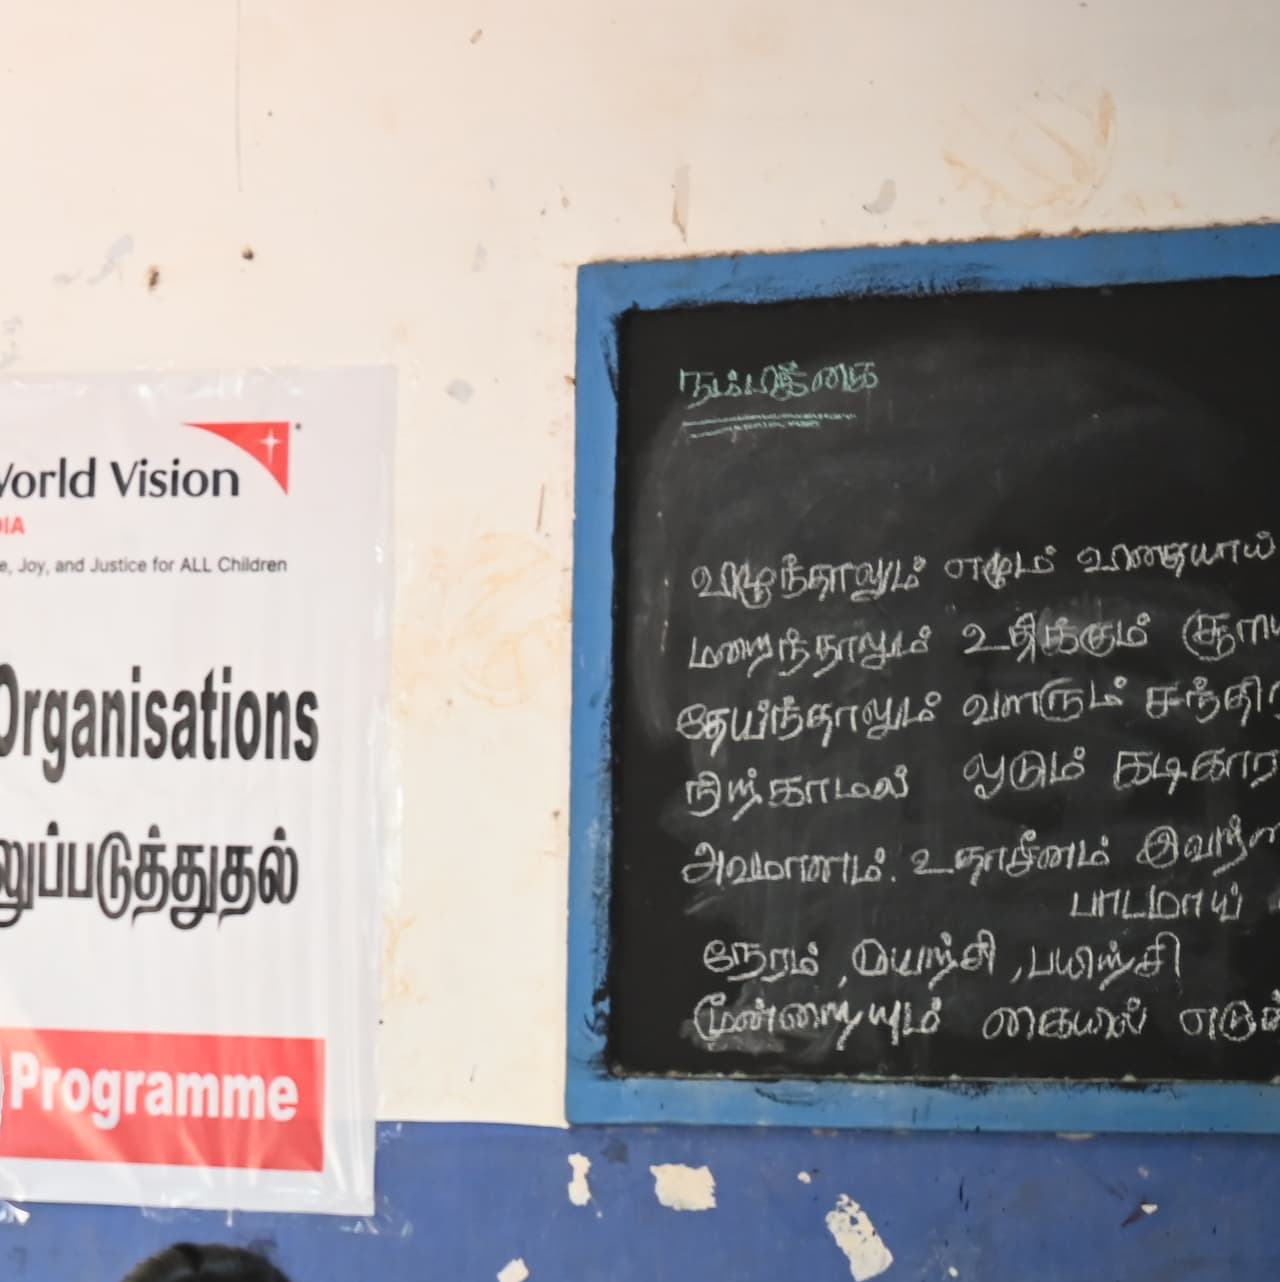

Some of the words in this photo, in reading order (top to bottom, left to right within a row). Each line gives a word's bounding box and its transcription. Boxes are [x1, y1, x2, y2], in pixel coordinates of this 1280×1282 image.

[110, 457, 240, 498] Vision
[17, 557, 51, 577] Joy,
[55, 557, 85, 574] and
[90, 557, 148, 574] Justice
[152, 557, 176, 574] for
[180, 557, 213, 574] ALL
[217, 557, 288, 574] Children
[9, 1050, 299, 1131] Programme
